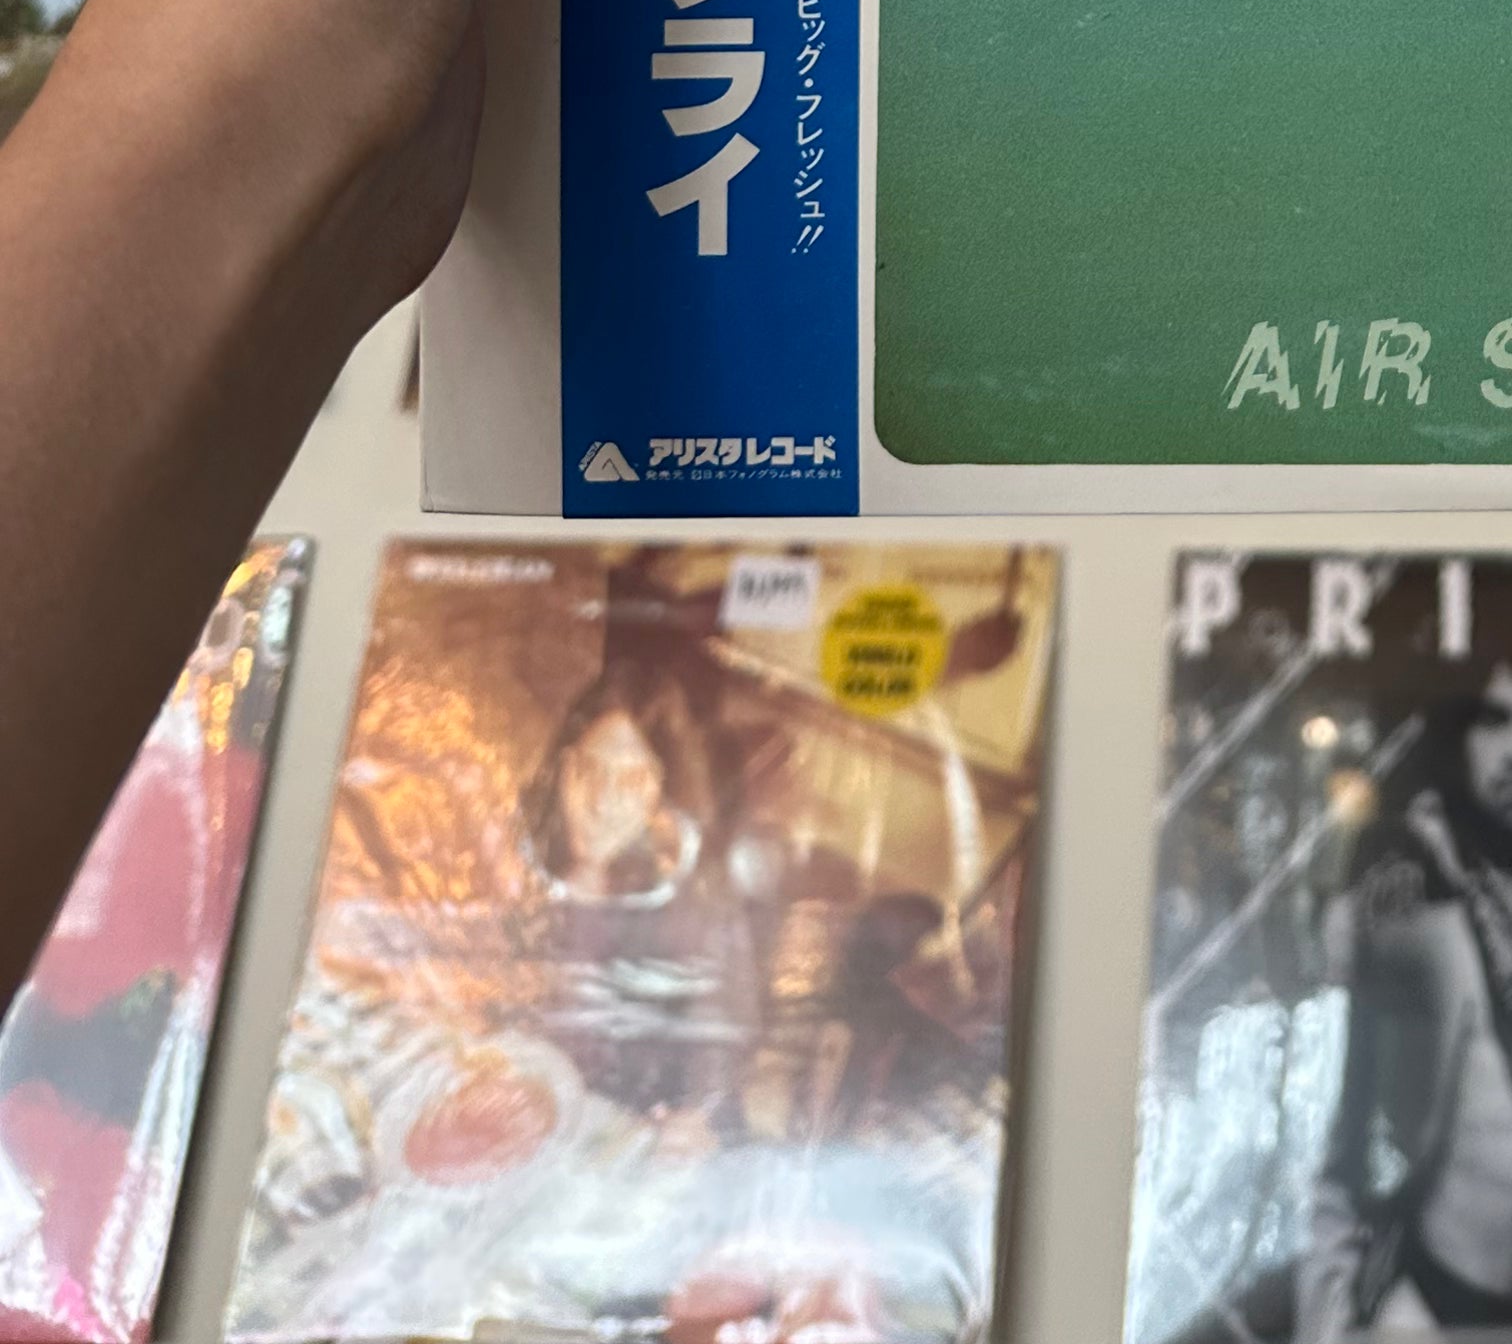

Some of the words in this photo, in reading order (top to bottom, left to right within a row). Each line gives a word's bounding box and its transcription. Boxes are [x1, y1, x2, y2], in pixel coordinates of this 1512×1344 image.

[1221, 316, 1433, 411] AIR
[648, 435, 837, 467] アリスタレコード
